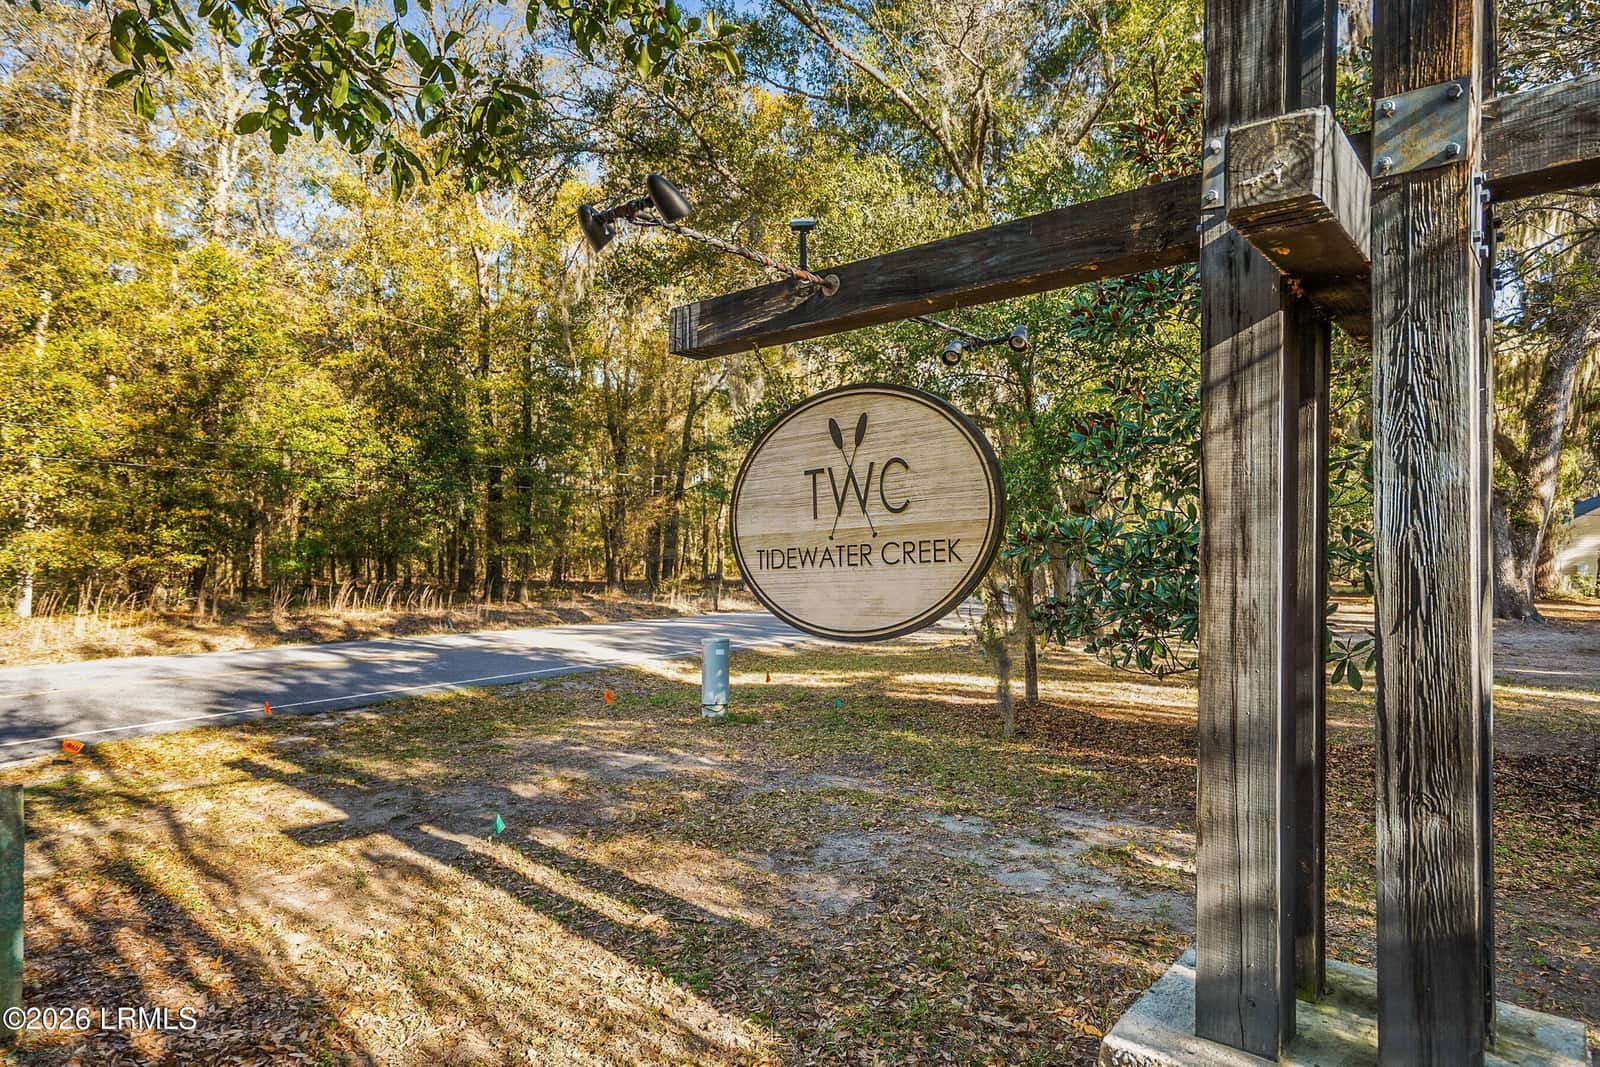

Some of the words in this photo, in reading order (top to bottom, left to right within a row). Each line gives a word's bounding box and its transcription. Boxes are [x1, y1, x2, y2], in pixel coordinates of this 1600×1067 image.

[804, 457, 910, 520] TWC
[756, 544, 873, 571] TIDEWATER
[881, 538, 963, 566] CREEK
